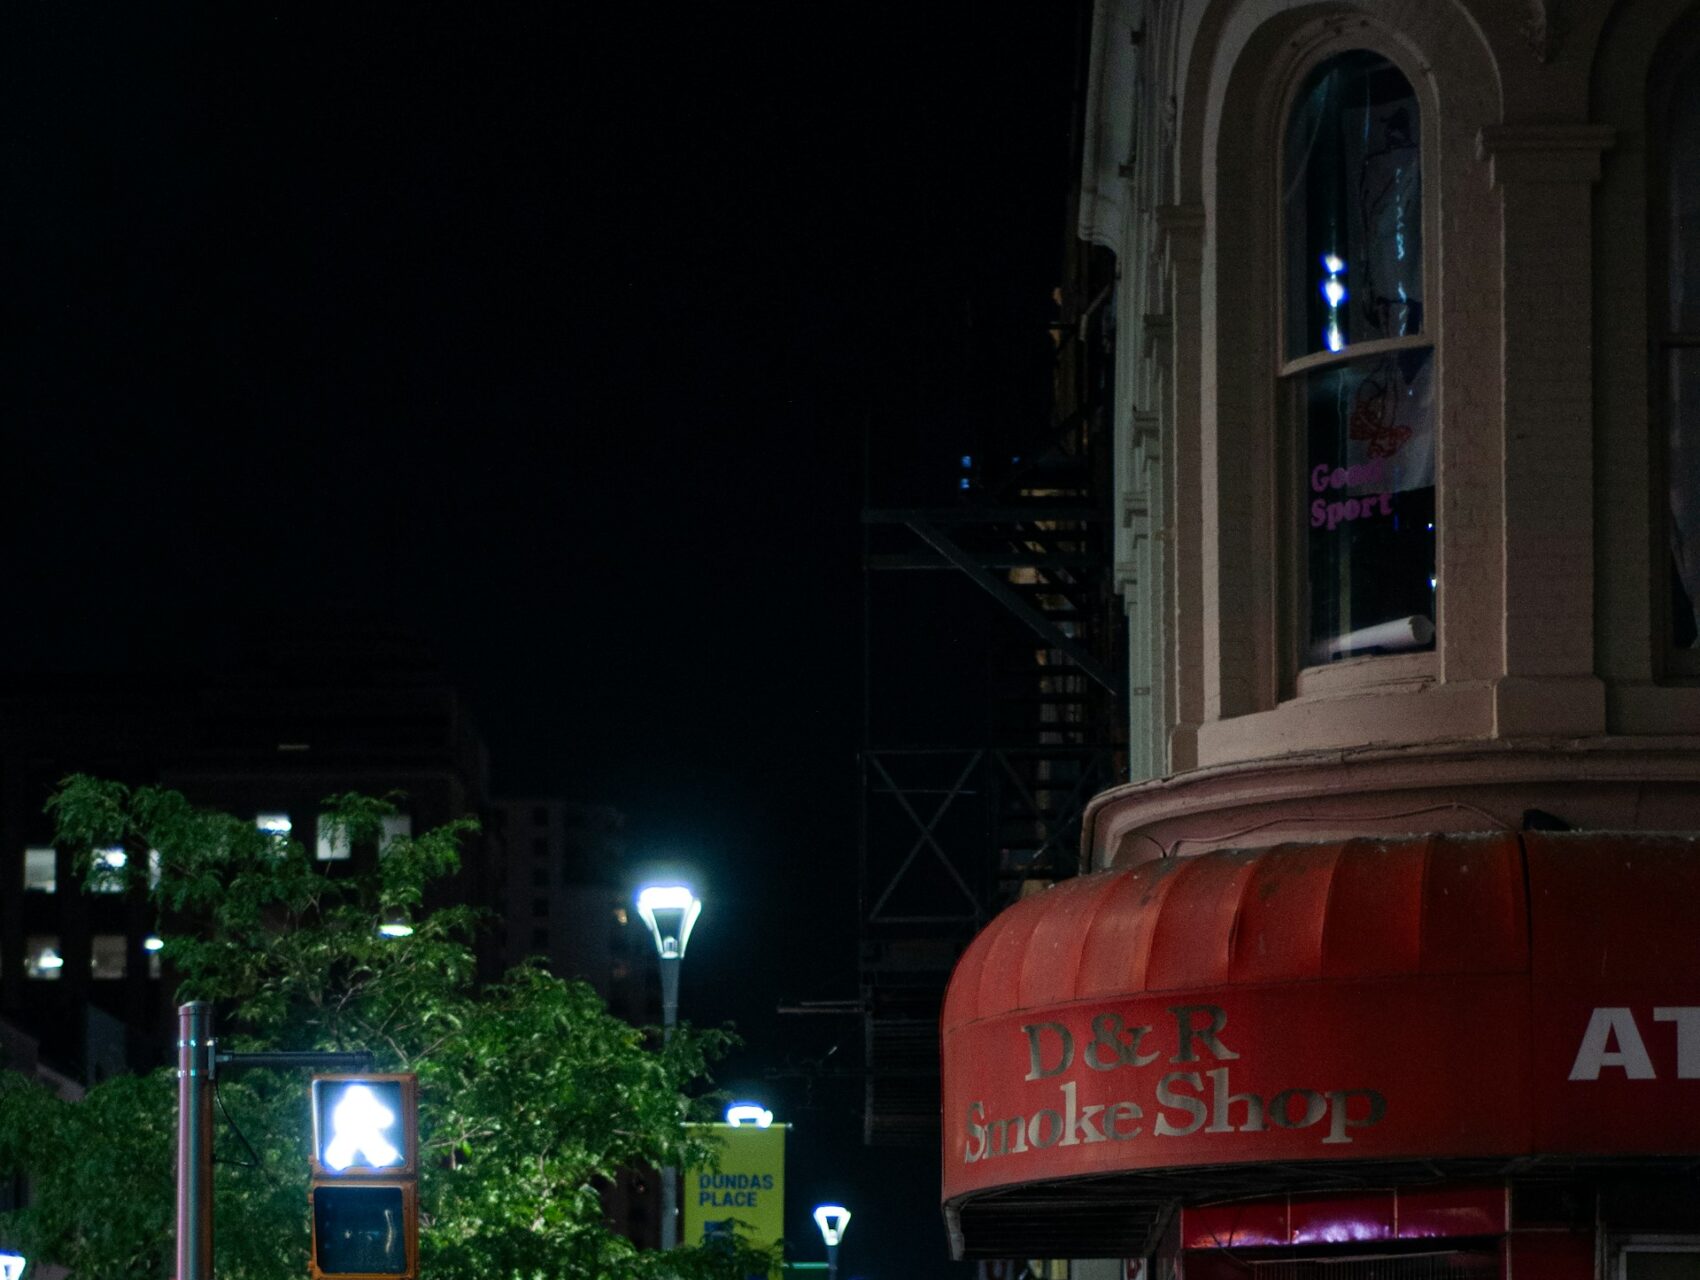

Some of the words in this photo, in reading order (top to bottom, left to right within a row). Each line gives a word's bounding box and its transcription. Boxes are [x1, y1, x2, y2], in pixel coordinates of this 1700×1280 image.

[1312, 493, 1393, 531] Sport
[1021, 1021, 1075, 1081] D
[1084, 1013, 1160, 1071] &
[1168, 1003, 1240, 1063] R
[964, 1081, 1144, 1163] Smoke
[1154, 1067, 1387, 1144] Shop
[699, 1174, 773, 1190] DUNDAS
[699, 1192, 757, 1207] PLACE
